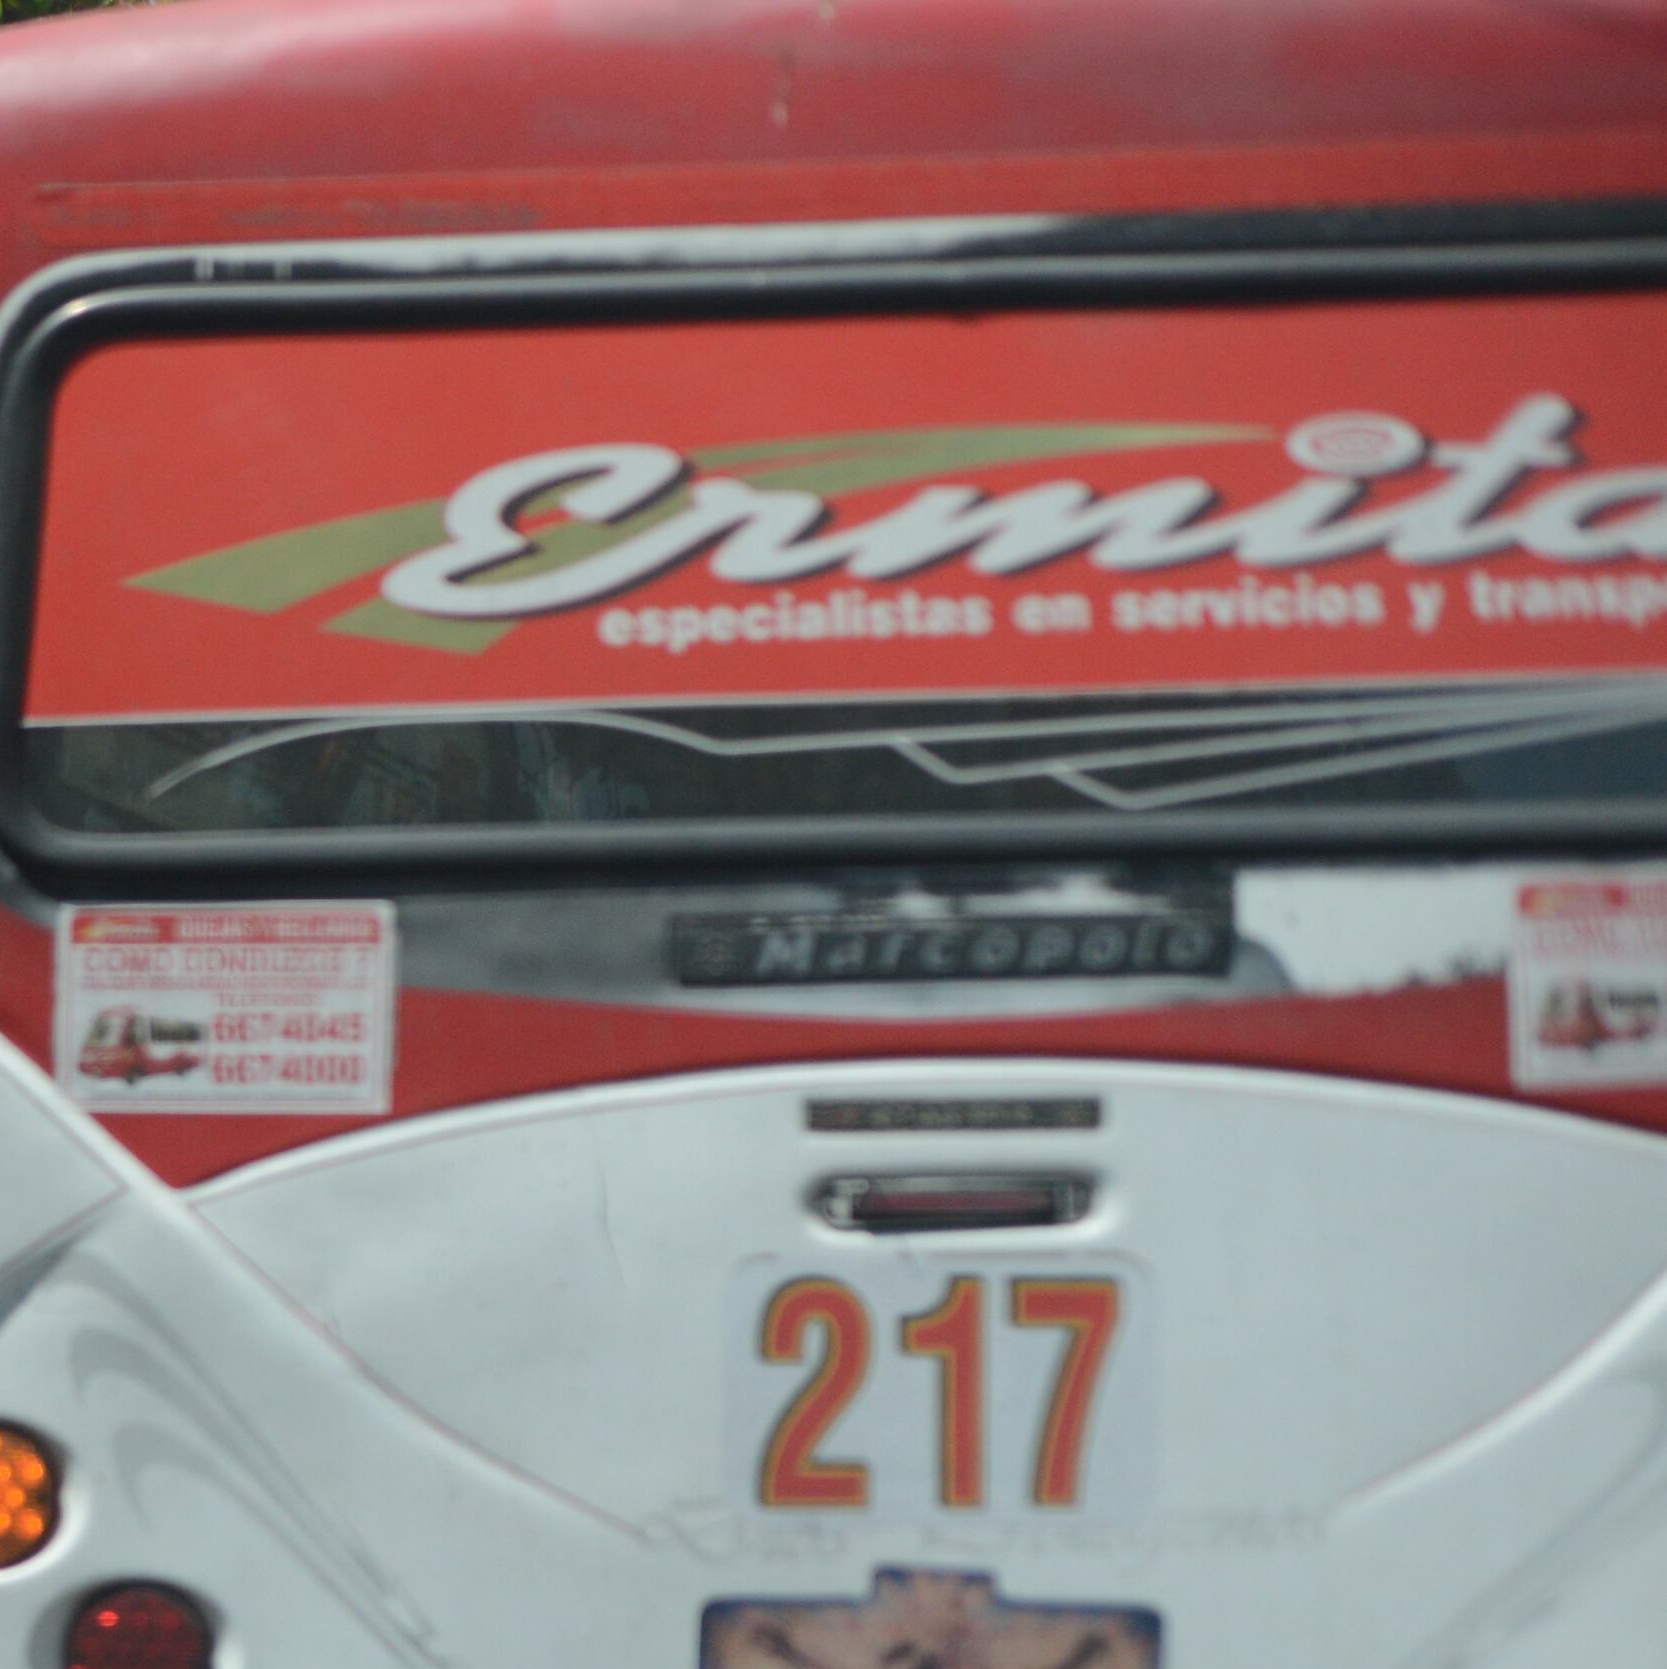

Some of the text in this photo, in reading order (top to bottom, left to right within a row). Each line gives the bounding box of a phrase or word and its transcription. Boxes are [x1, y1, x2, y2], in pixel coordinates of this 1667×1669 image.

[380, 392, 1667, 622] Ermita
[597, 571, 1667, 654] especialistas en servicios y transp
[756, 918, 1216, 975] Marcopolo
[757, 1275, 1122, 1510] 217
